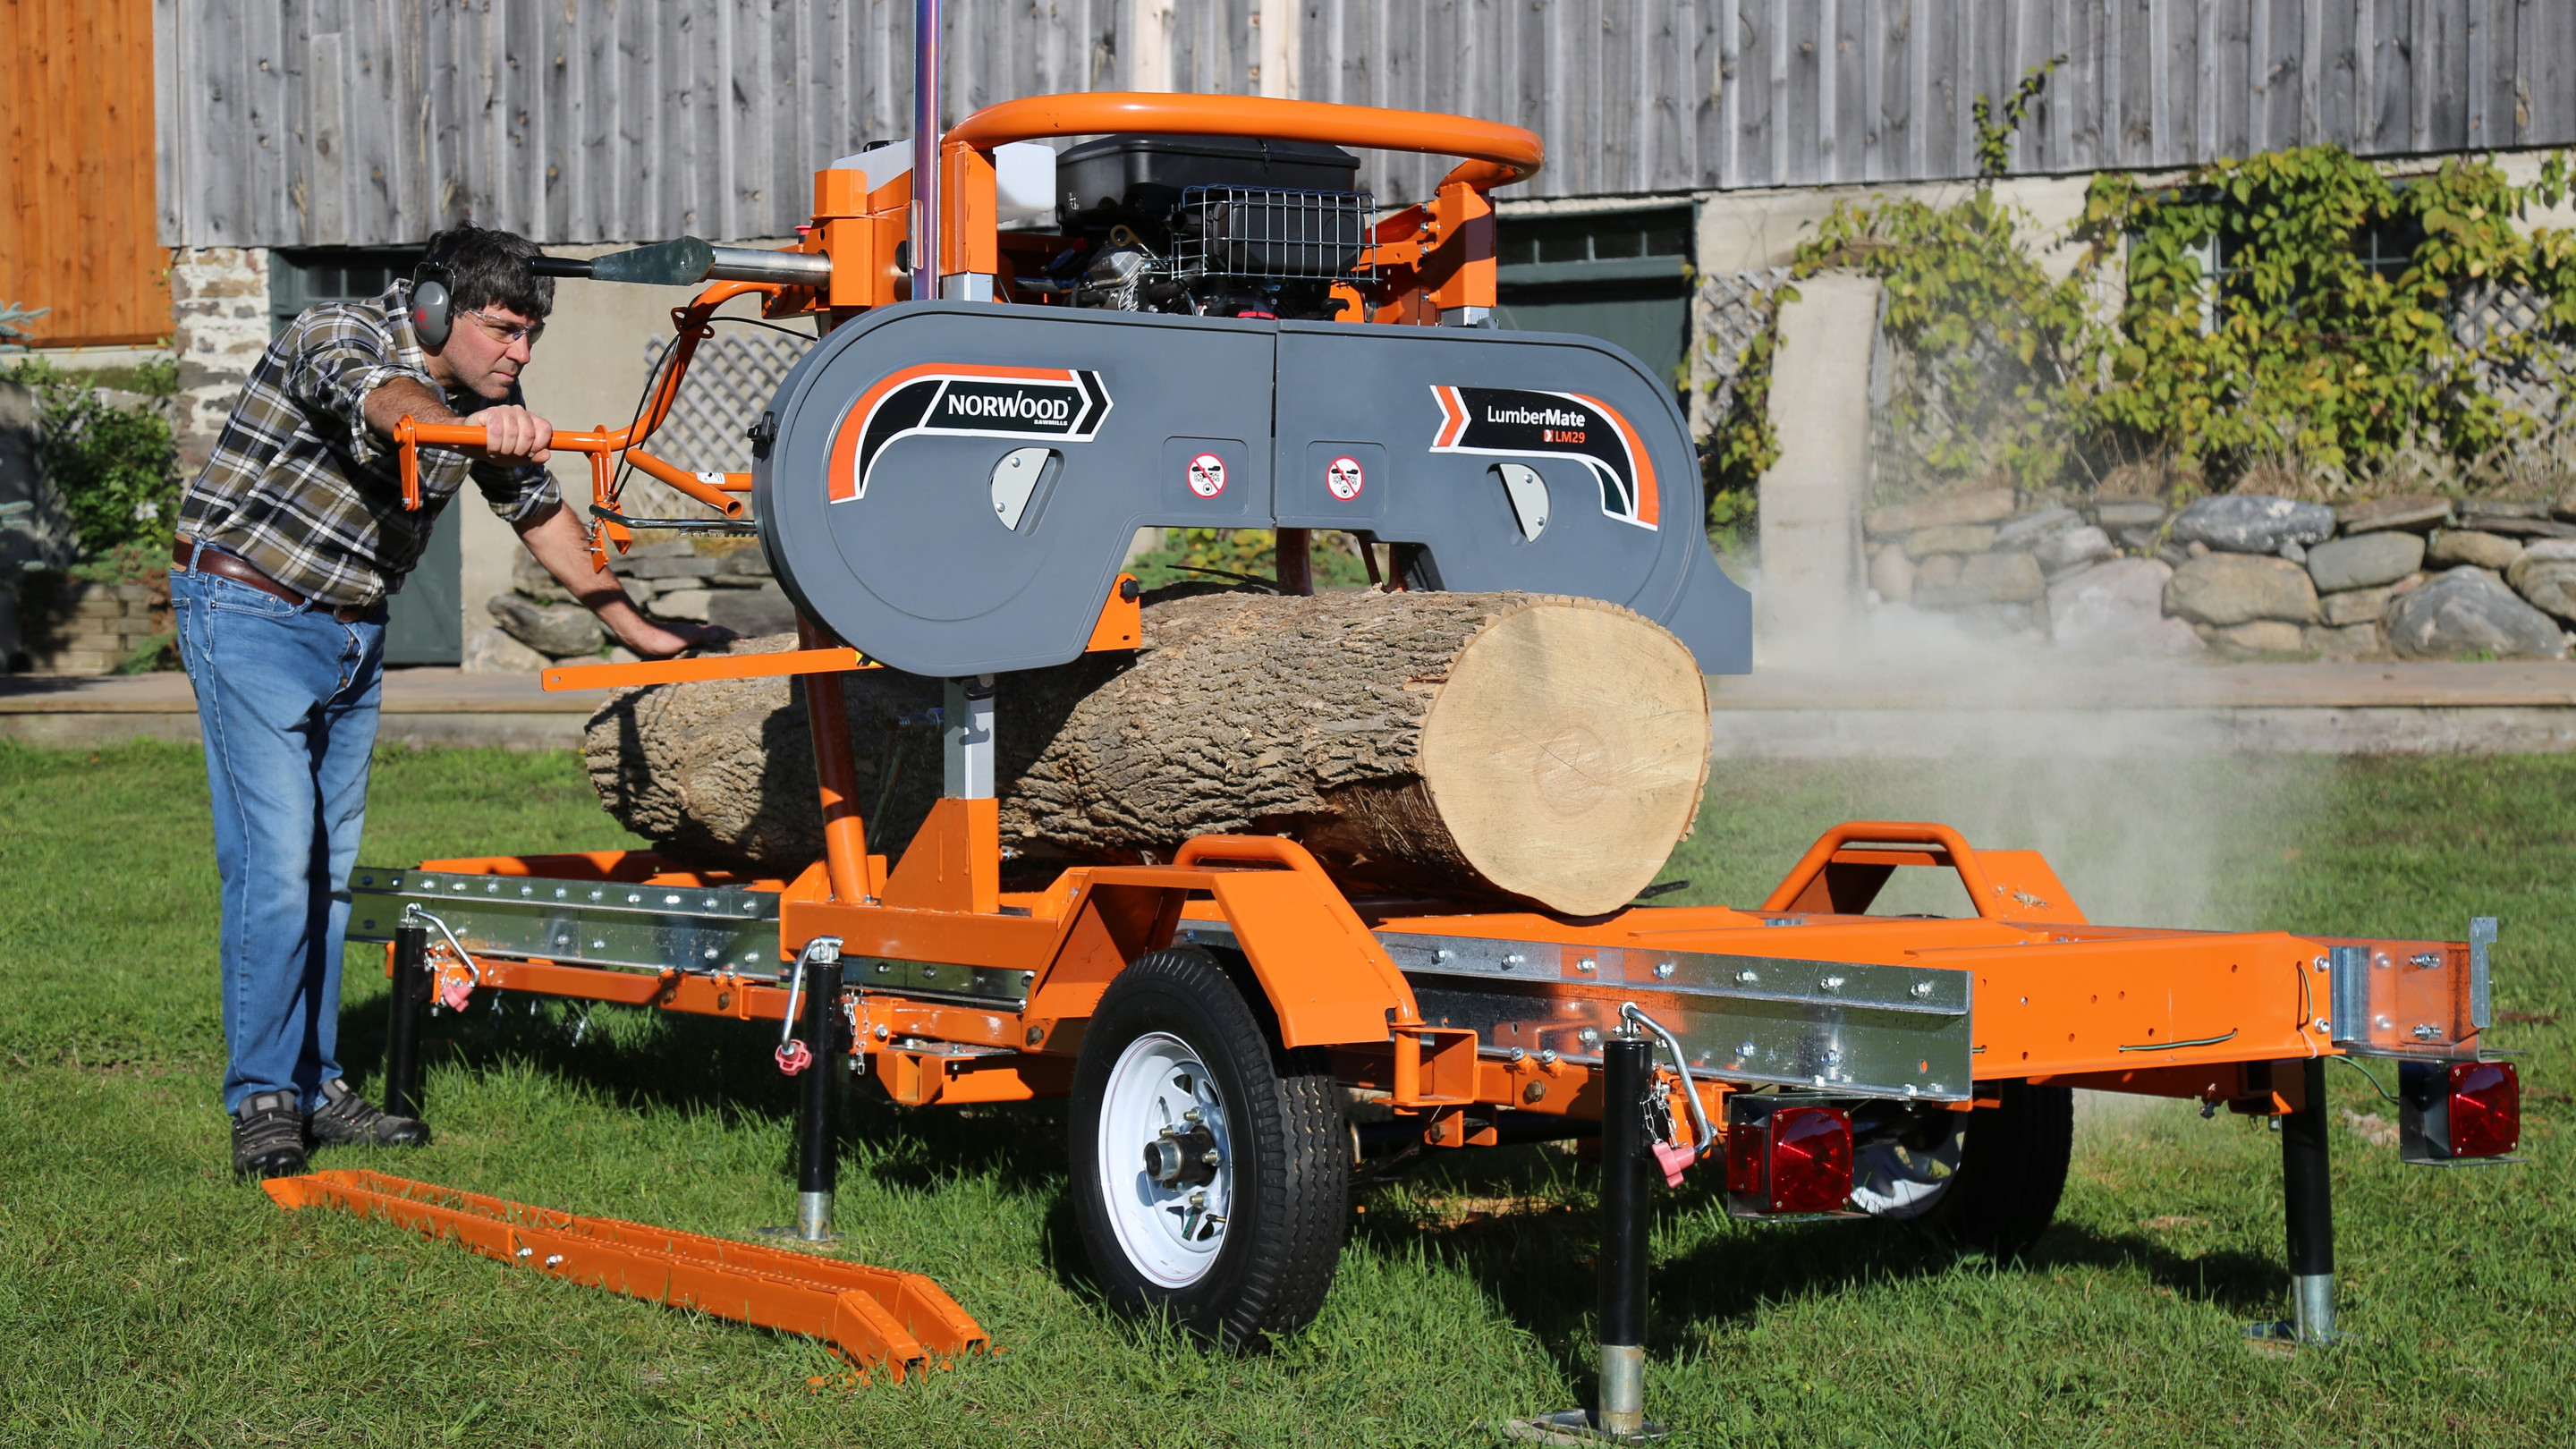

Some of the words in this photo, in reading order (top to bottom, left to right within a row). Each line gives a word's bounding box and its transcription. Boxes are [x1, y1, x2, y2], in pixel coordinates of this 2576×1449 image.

[948, 390, 1069, 419] NORWOOD
[1487, 405, 1586, 428] LumberMate
[1555, 431, 1586, 444] LM29
